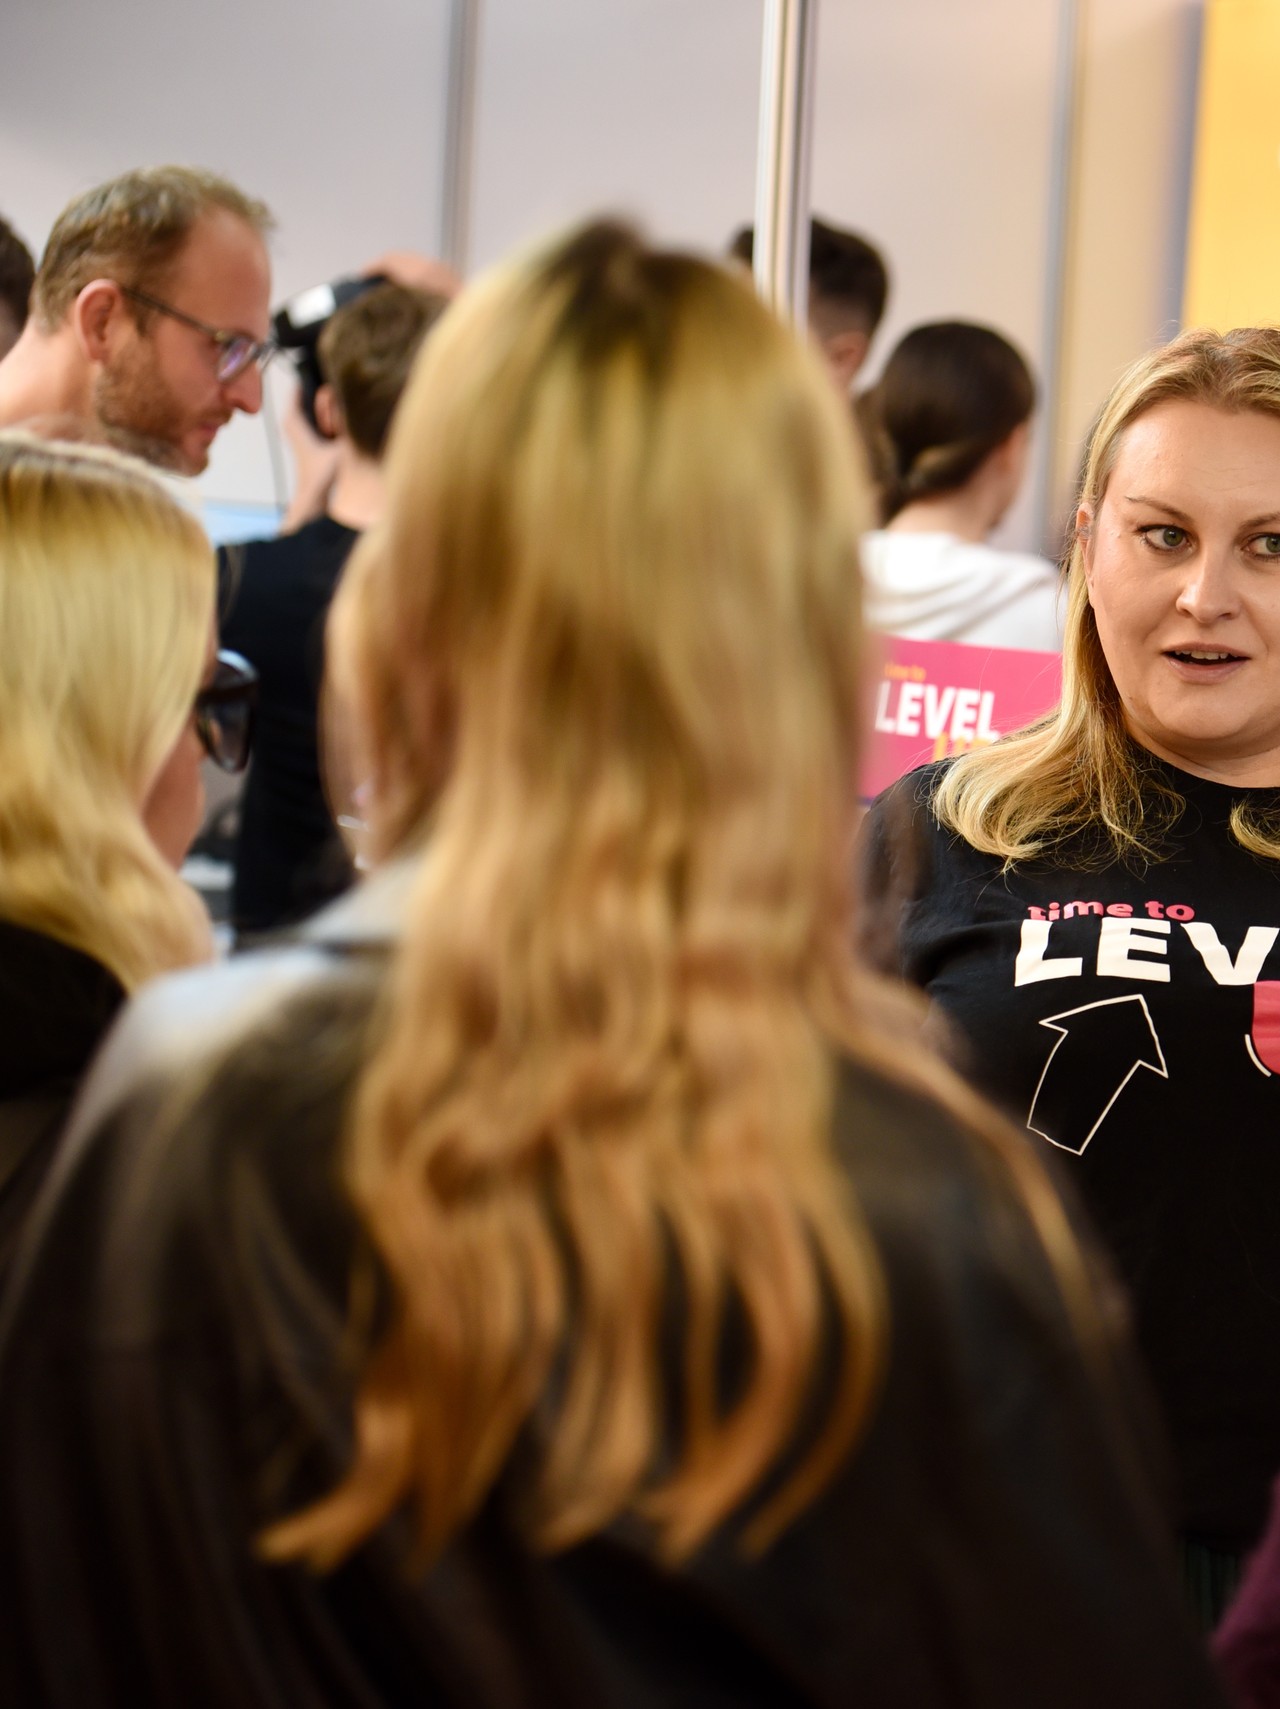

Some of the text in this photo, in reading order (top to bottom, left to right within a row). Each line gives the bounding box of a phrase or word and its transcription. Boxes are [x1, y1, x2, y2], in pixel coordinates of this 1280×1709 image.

[875, 680, 1000, 744] LEVEL
[1027, 900, 1195, 921] time to
